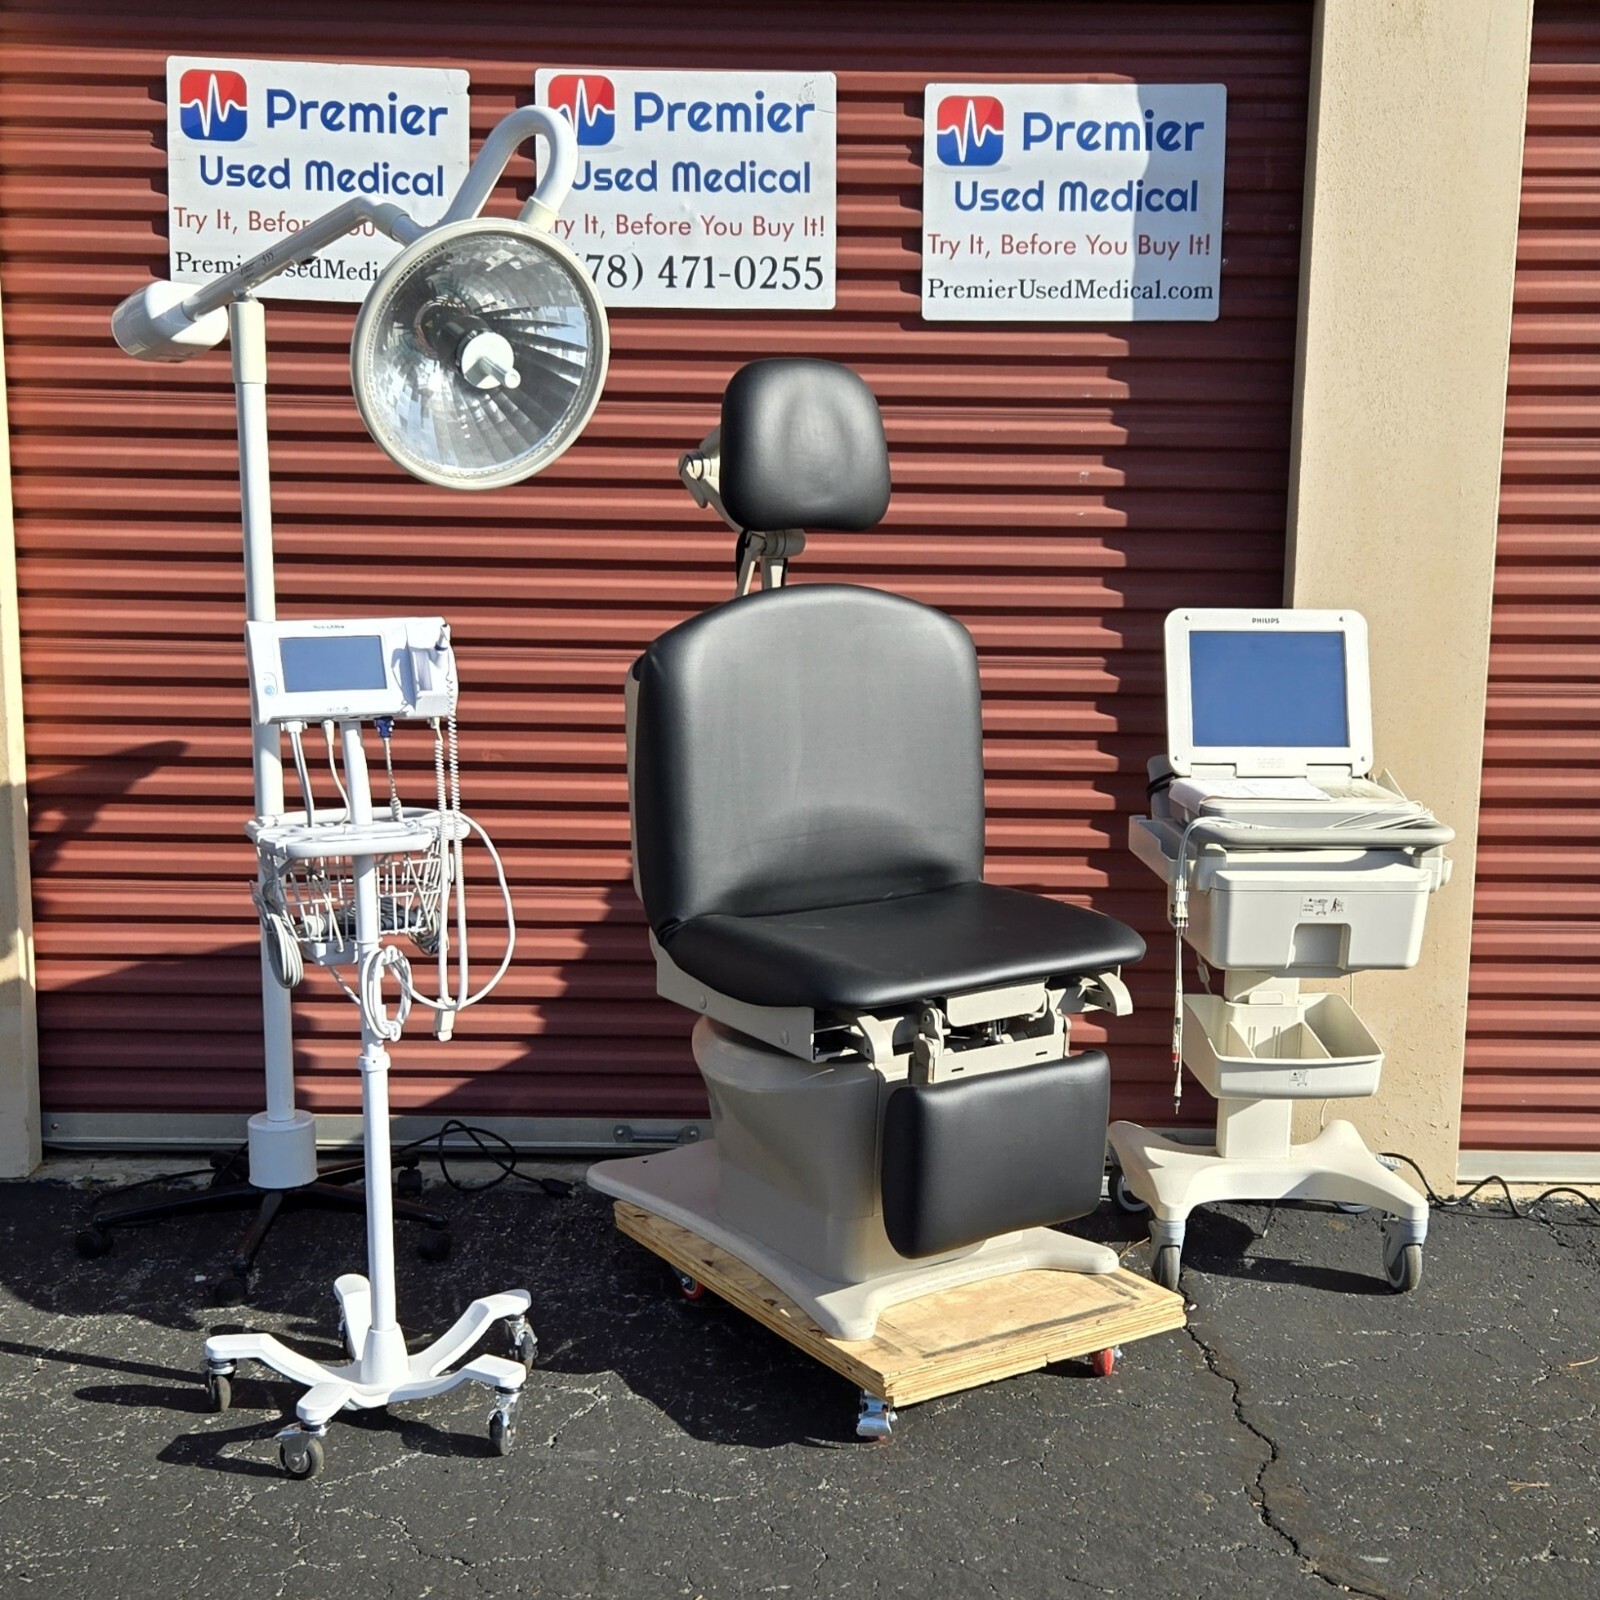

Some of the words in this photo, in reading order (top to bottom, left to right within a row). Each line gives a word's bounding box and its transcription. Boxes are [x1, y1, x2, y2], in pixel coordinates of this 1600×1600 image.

[267, 88, 449, 137] Premier
[634, 90, 815, 133] Premier
[1023, 109, 1205, 152] Premier
[200, 154, 291, 190] Used
[305, 160, 444, 197] Medical
[672, 161, 811, 193] Medical
[955, 180, 1044, 212] Used
[1059, 180, 1198, 212] Medical
[174, 207, 207, 233] Try
[217, 209, 238, 234] It,
[249, 211, 311, 234] Befor
[549, 220, 575, 239] ry
[585, 213, 605, 239] It,
[616, 213, 692, 236] Before
[701, 215, 743, 237] You
[753, 215, 795, 241] Buy
[804, 216, 825, 237] It!
[927, 234, 960, 260] Try
[970, 234, 990, 258] It,
[1001, 234, 1077, 256] Before
[1086, 234, 1128, 256] You
[1138, 234, 1181, 261] Buy
[1189, 234, 1211, 256] It!
[658, 255, 823, 290] 471-0255
[928, 278, 1214, 300] PremierUsedMedical.com
